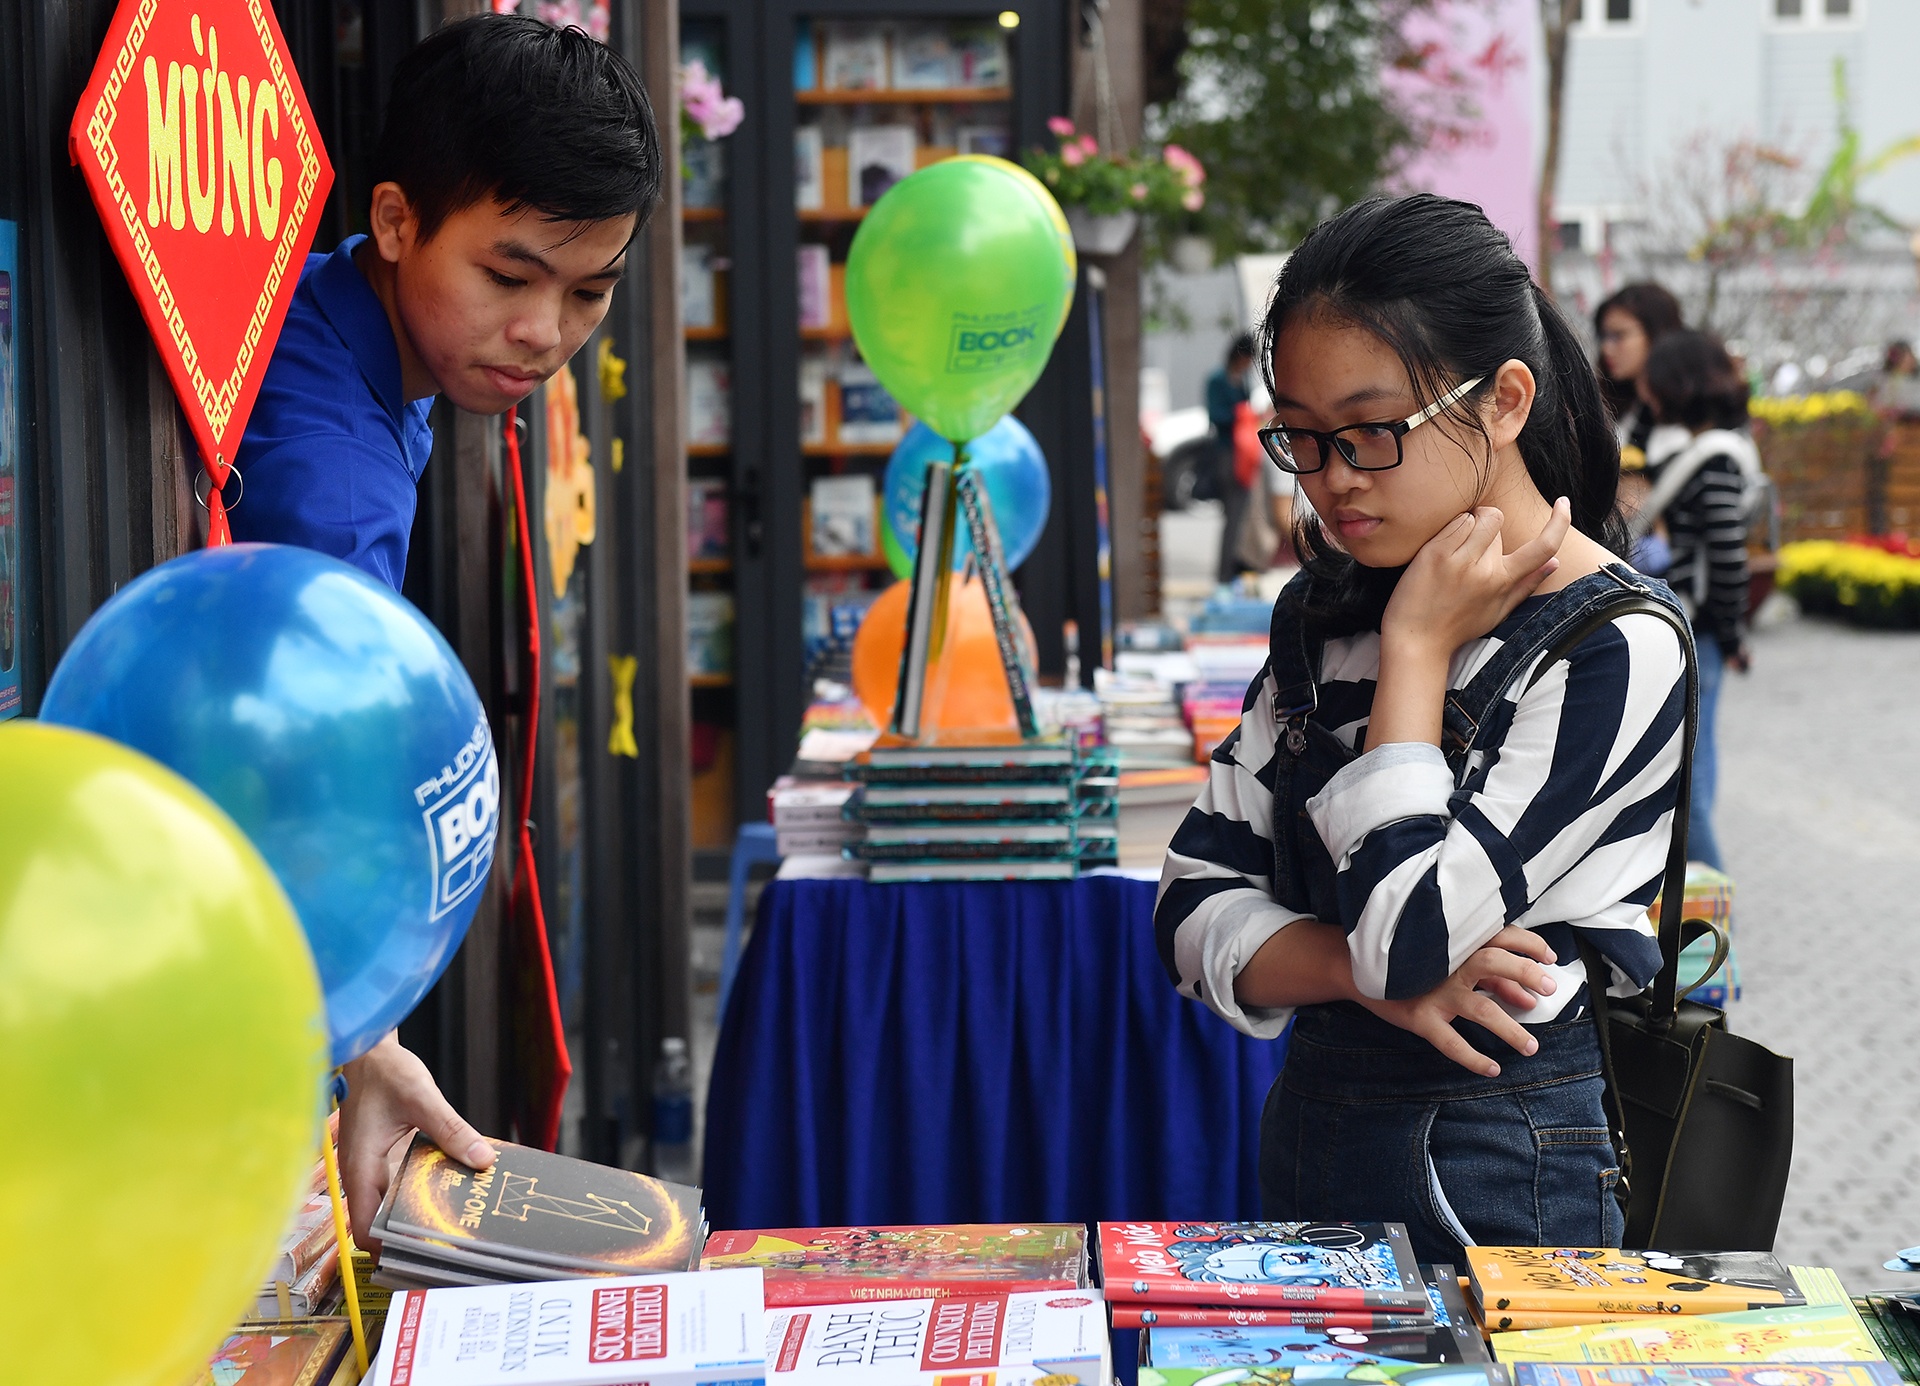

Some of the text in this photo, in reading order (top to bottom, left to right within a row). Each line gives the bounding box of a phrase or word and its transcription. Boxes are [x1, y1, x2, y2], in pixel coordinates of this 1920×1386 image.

[143, 13, 283, 241] MỪNG
[958, 322, 1038, 352] BOOK
[438, 756, 500, 864] BOO
[876, 1287, 903, 1299] NAM
[533, 1298, 572, 1357] MIND
[813, 1310, 874, 1368] ĐÁNH
[868, 1307, 926, 1365] THỨC
[928, 1335, 961, 1363] CON
